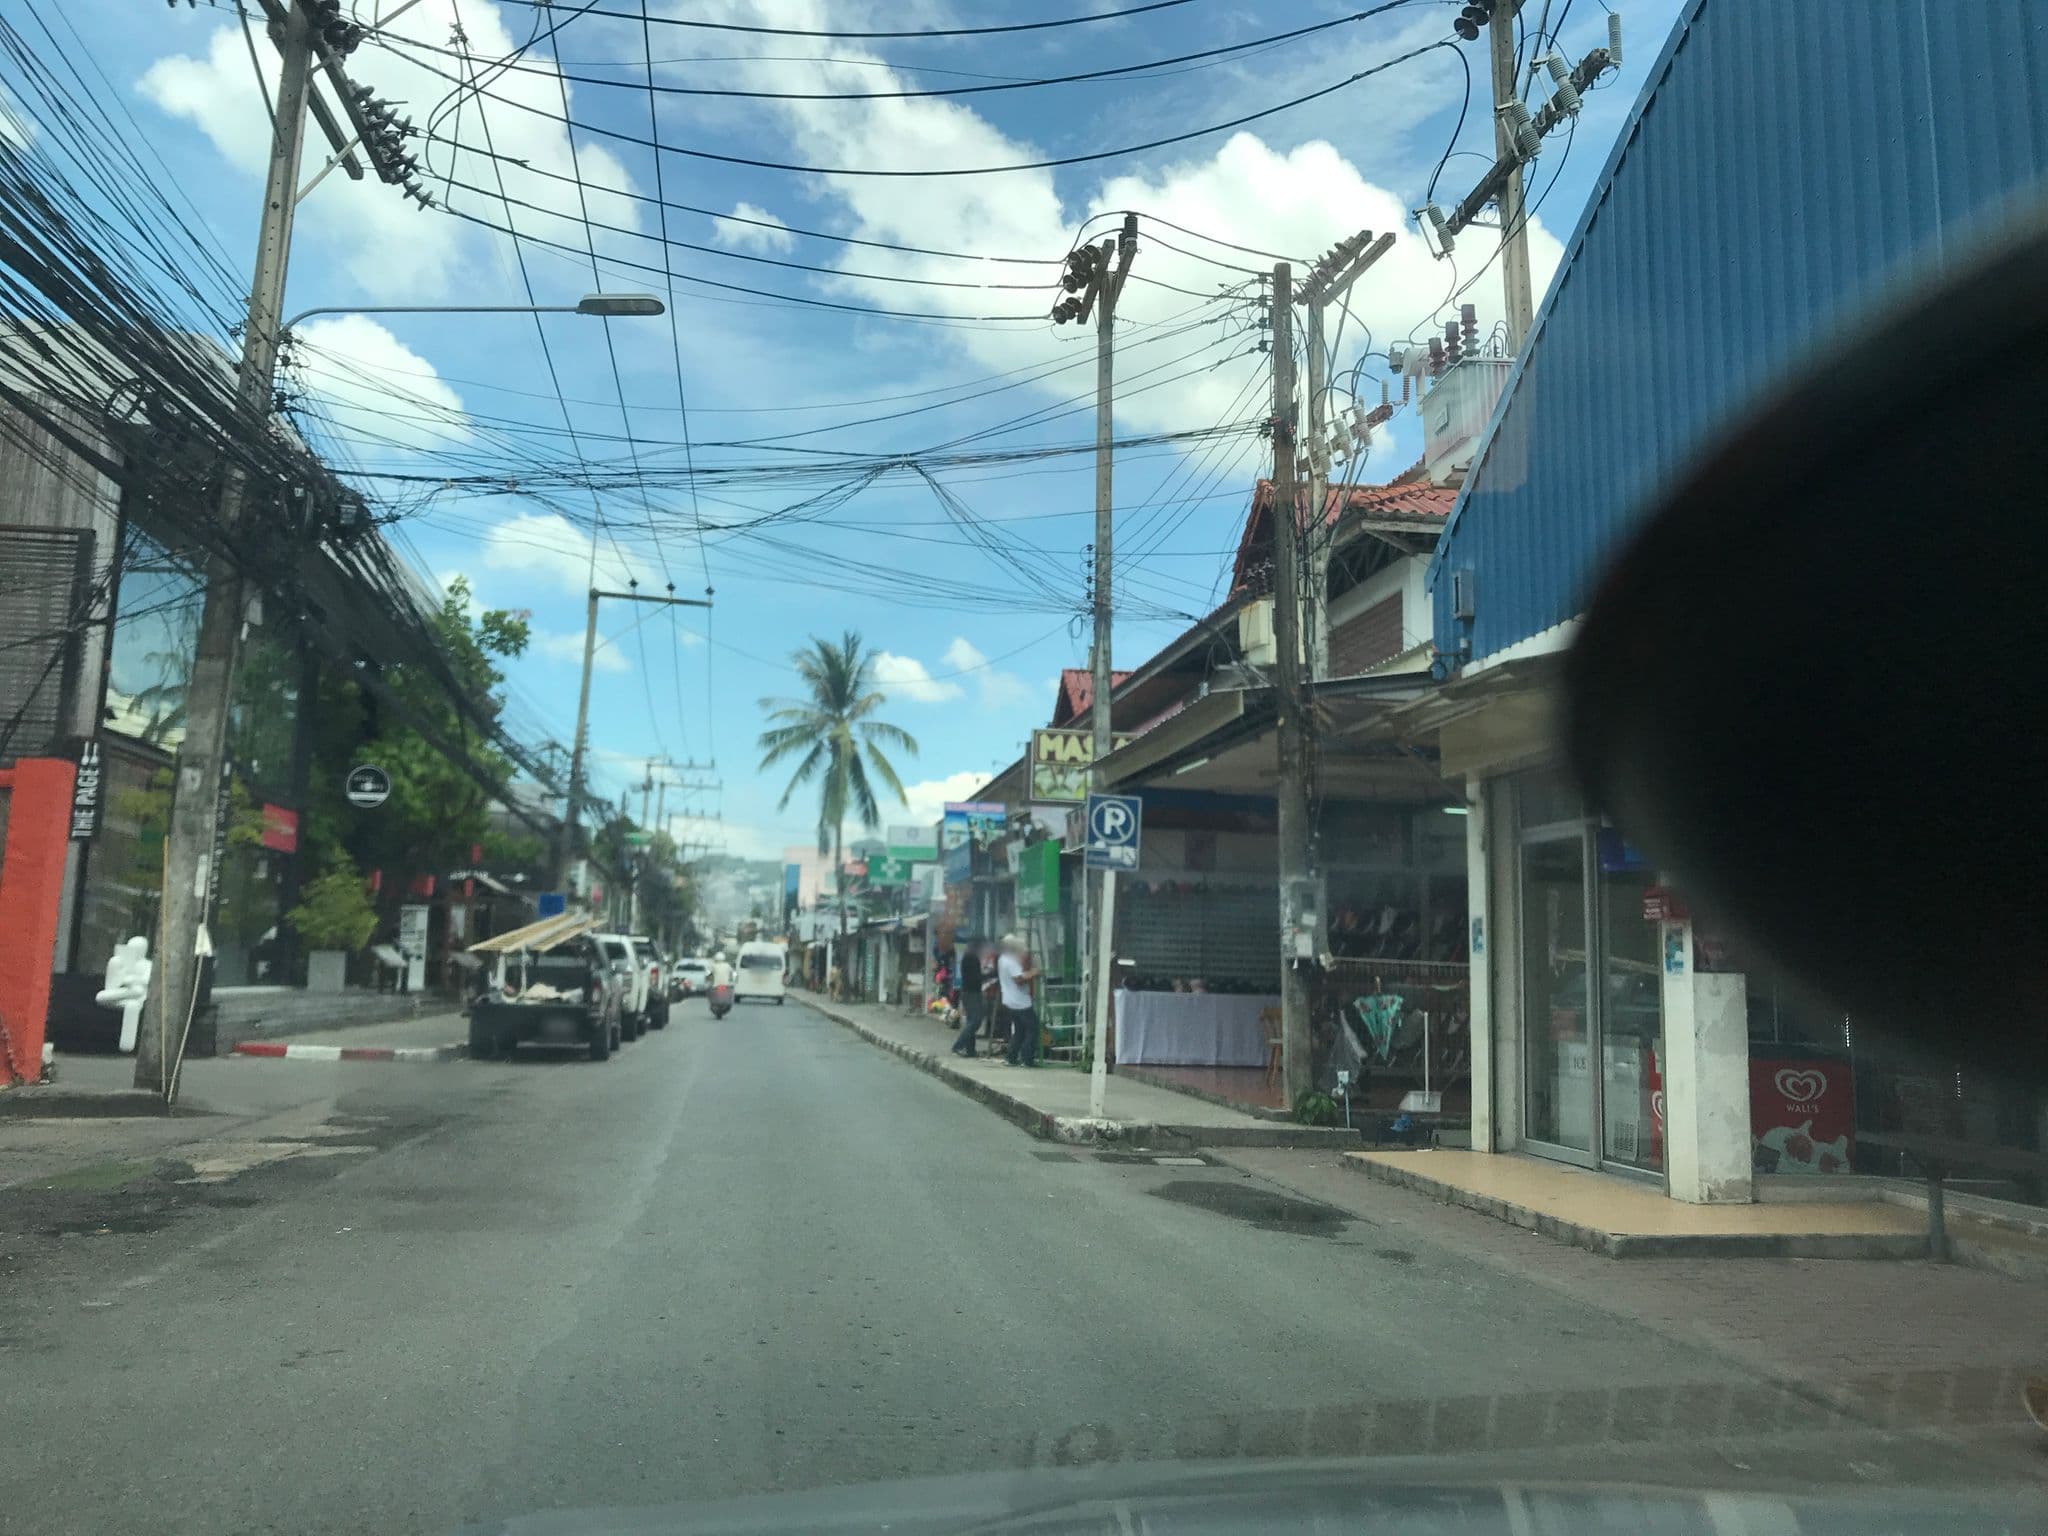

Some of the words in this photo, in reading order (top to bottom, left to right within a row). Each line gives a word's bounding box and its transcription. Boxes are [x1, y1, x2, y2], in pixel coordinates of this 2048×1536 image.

[1039, 733, 1129, 763] MAS
[75, 766, 99, 806] PAGE
[71, 808, 95, 837] THE
